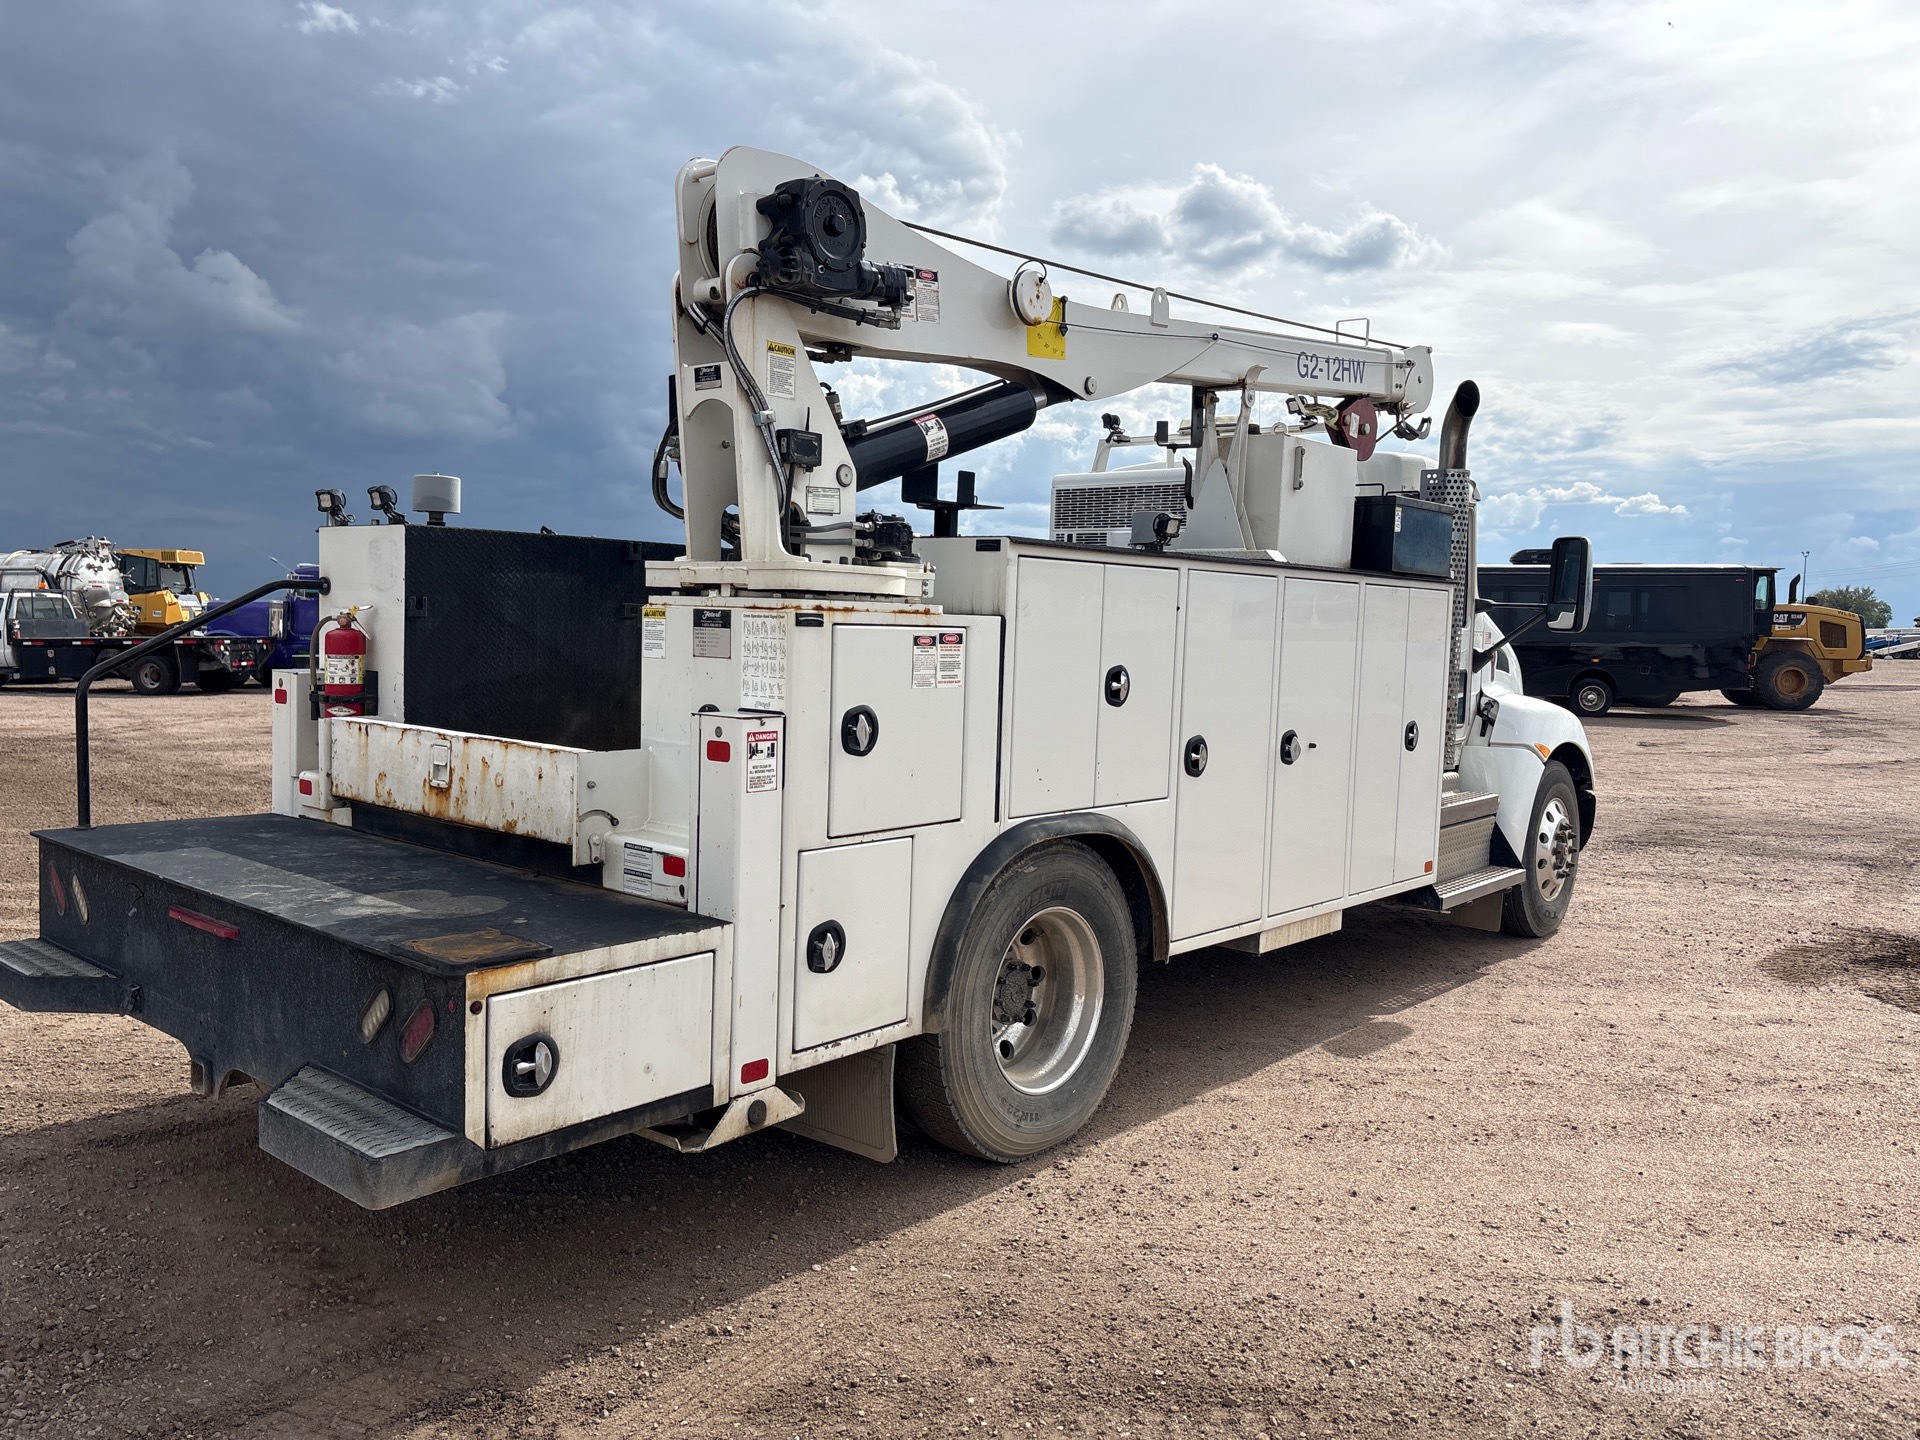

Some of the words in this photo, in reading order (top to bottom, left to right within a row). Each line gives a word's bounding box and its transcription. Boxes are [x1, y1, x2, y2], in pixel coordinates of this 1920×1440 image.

[775, 344, 795, 356] CAUTION
[1297, 351, 1366, 384] G2-12HW
[1773, 613, 1789, 623] CAT
[755, 732, 777, 741] DANGER
